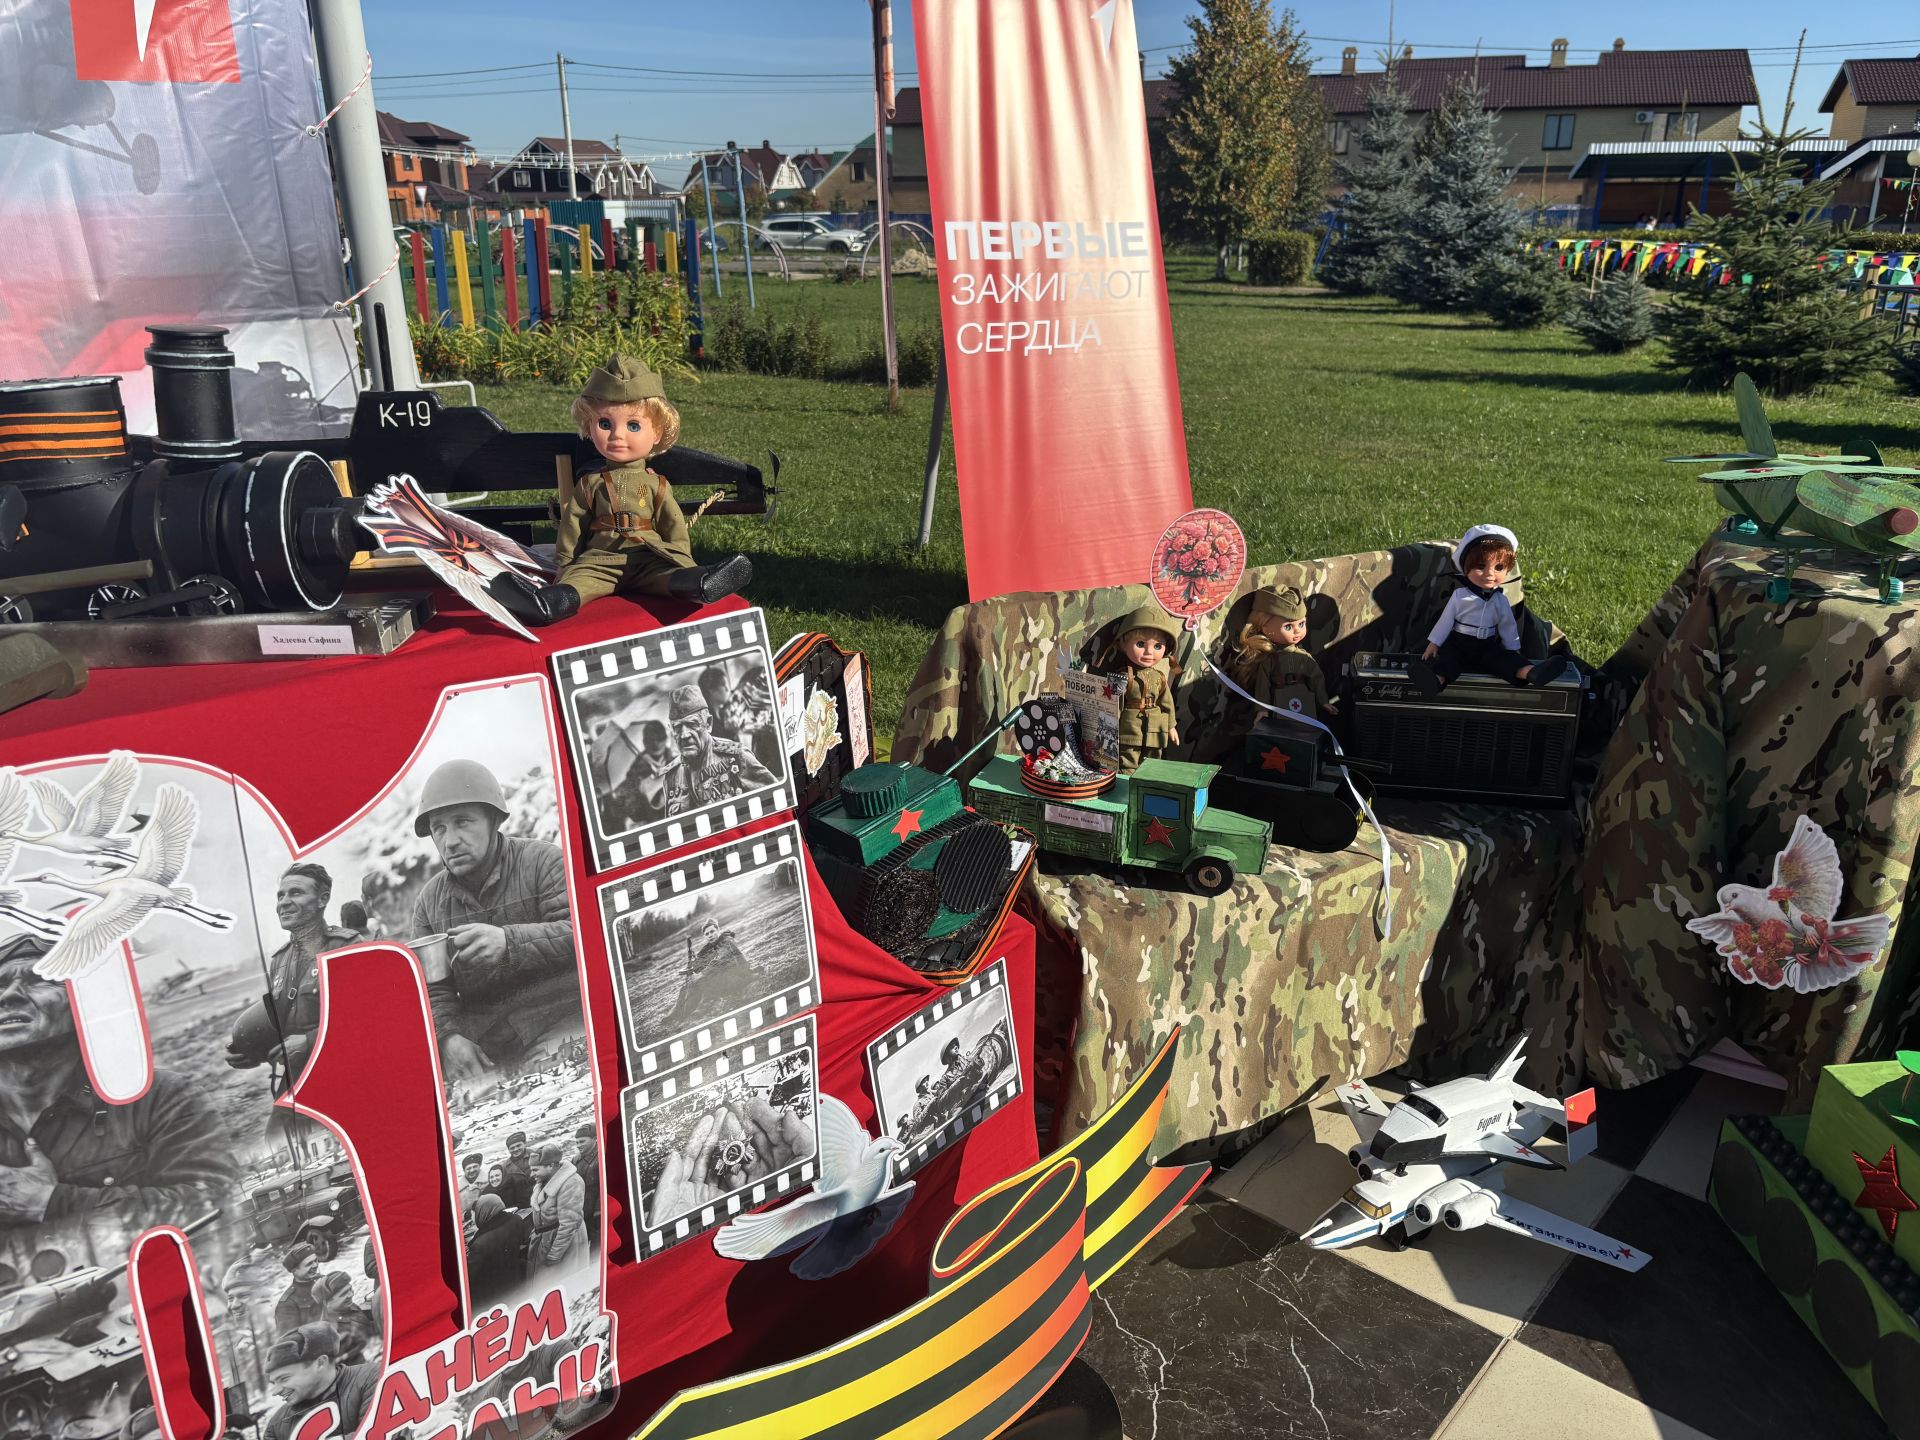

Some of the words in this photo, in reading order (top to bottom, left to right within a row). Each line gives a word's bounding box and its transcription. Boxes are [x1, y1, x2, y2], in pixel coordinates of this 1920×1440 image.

[944, 221, 1149, 261] ПЕРВЫЕ
[951, 270, 1149, 306] ЗАЖИГАЮТ
[956, 319, 1102, 357] СЕРДЦА
[366, 1289, 567, 1440] ДНЁМ
